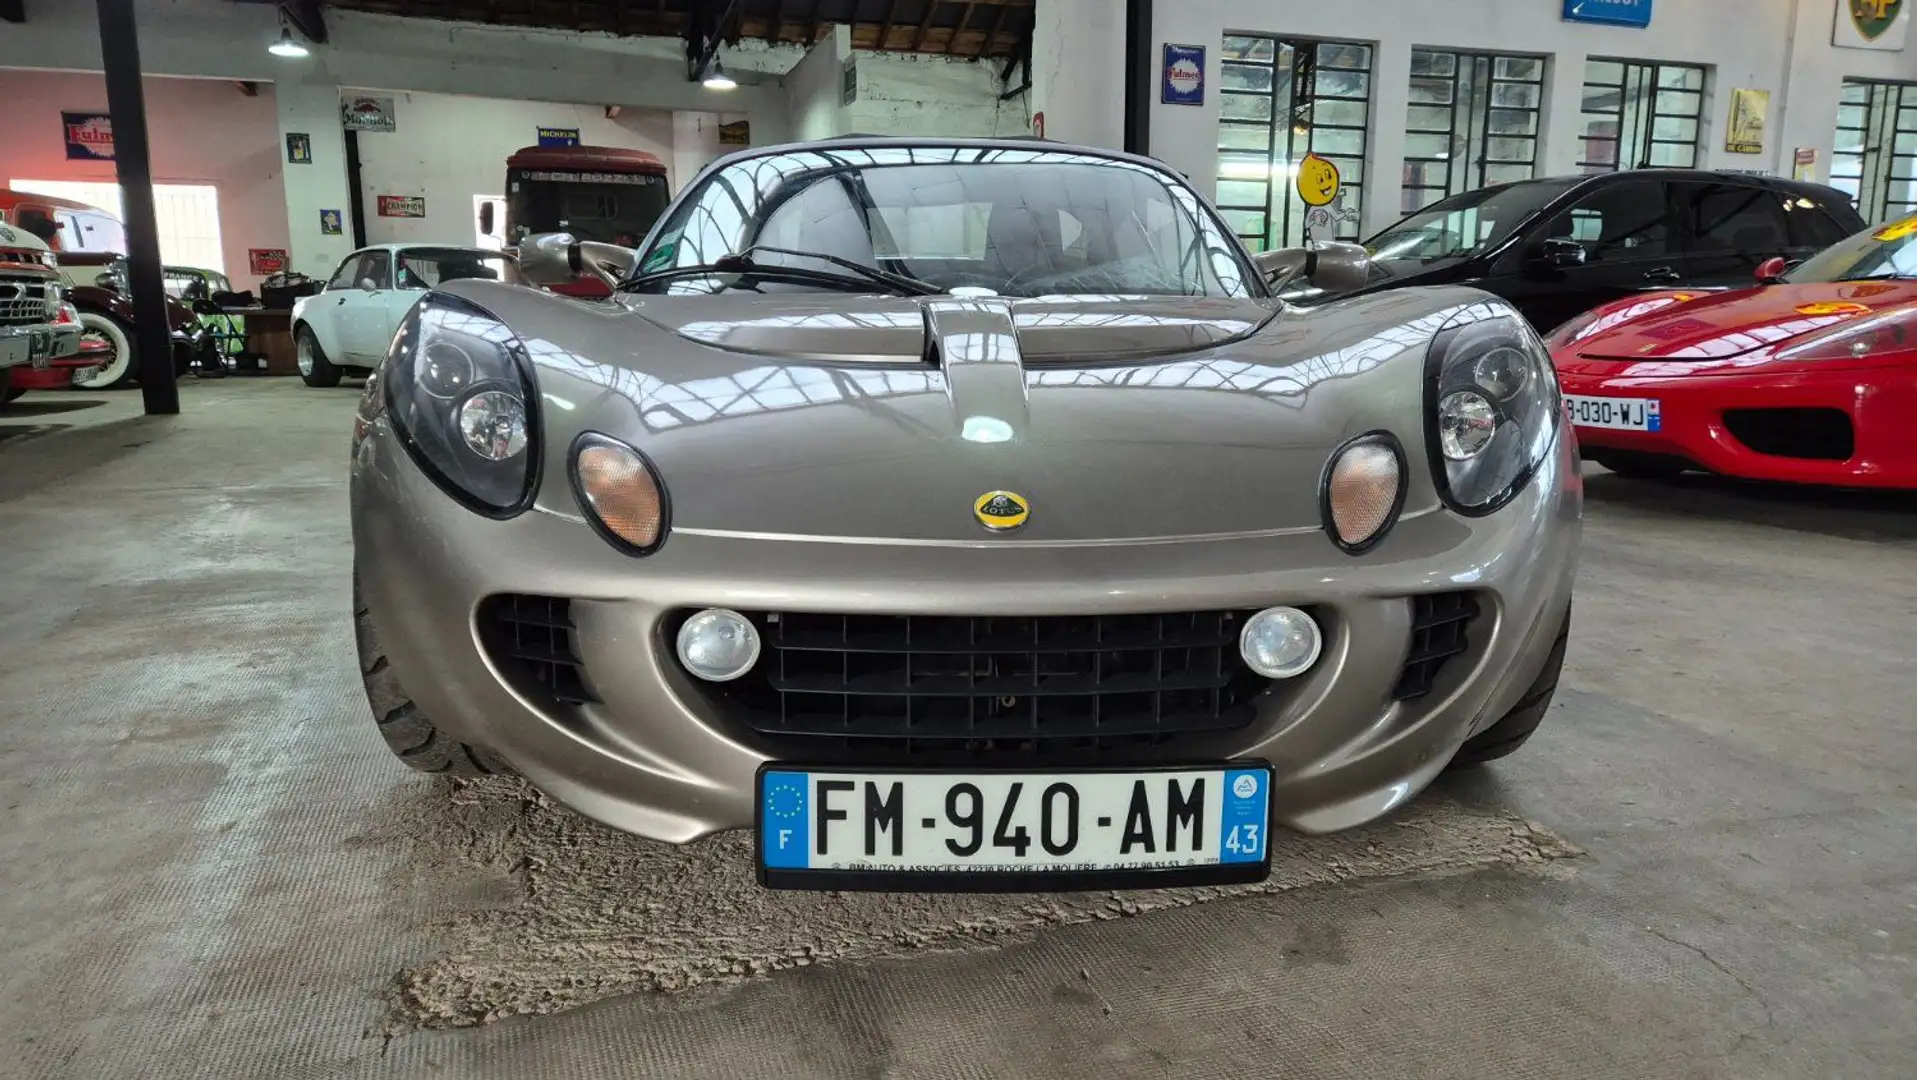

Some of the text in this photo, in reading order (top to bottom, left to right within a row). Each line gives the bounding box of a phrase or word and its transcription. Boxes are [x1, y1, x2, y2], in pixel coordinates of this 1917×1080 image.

[540, 130, 577, 138] MICHELIN
[387, 201, 422, 210] CHAMPION
[1567, 399, 1644, 425] B-030-WJ
[817, 778, 1205, 857] FM-940-AM
[779, 829, 792, 849] F
[1226, 825, 1259, 854] 43
